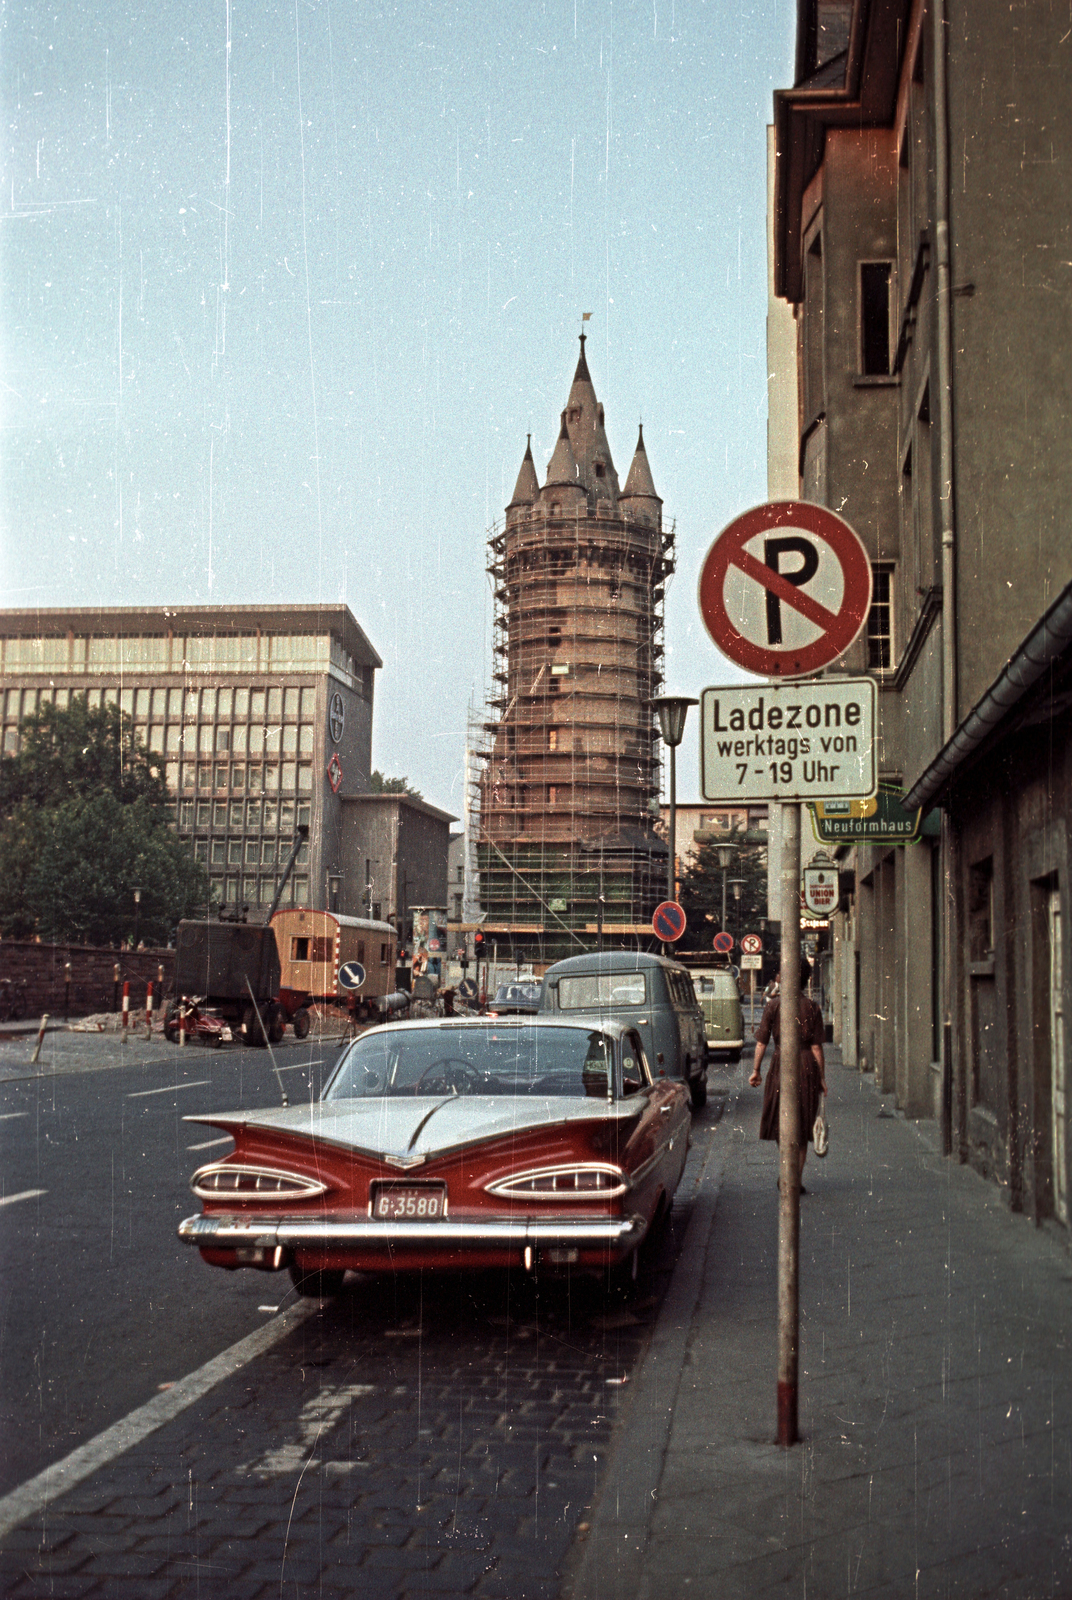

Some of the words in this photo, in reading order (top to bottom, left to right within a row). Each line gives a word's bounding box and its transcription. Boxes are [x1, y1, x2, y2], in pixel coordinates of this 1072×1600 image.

[764, 536, 819, 645] P
[713, 697, 861, 732] Ladezone
[717, 734, 811, 760] werktags
[820, 735, 857, 753] von
[803, 760, 840, 783] Uhr
[824, 818, 911, 832] Neuformhaus
[809, 889, 835, 898] UNION
[814, 897, 831, 905] BIER
